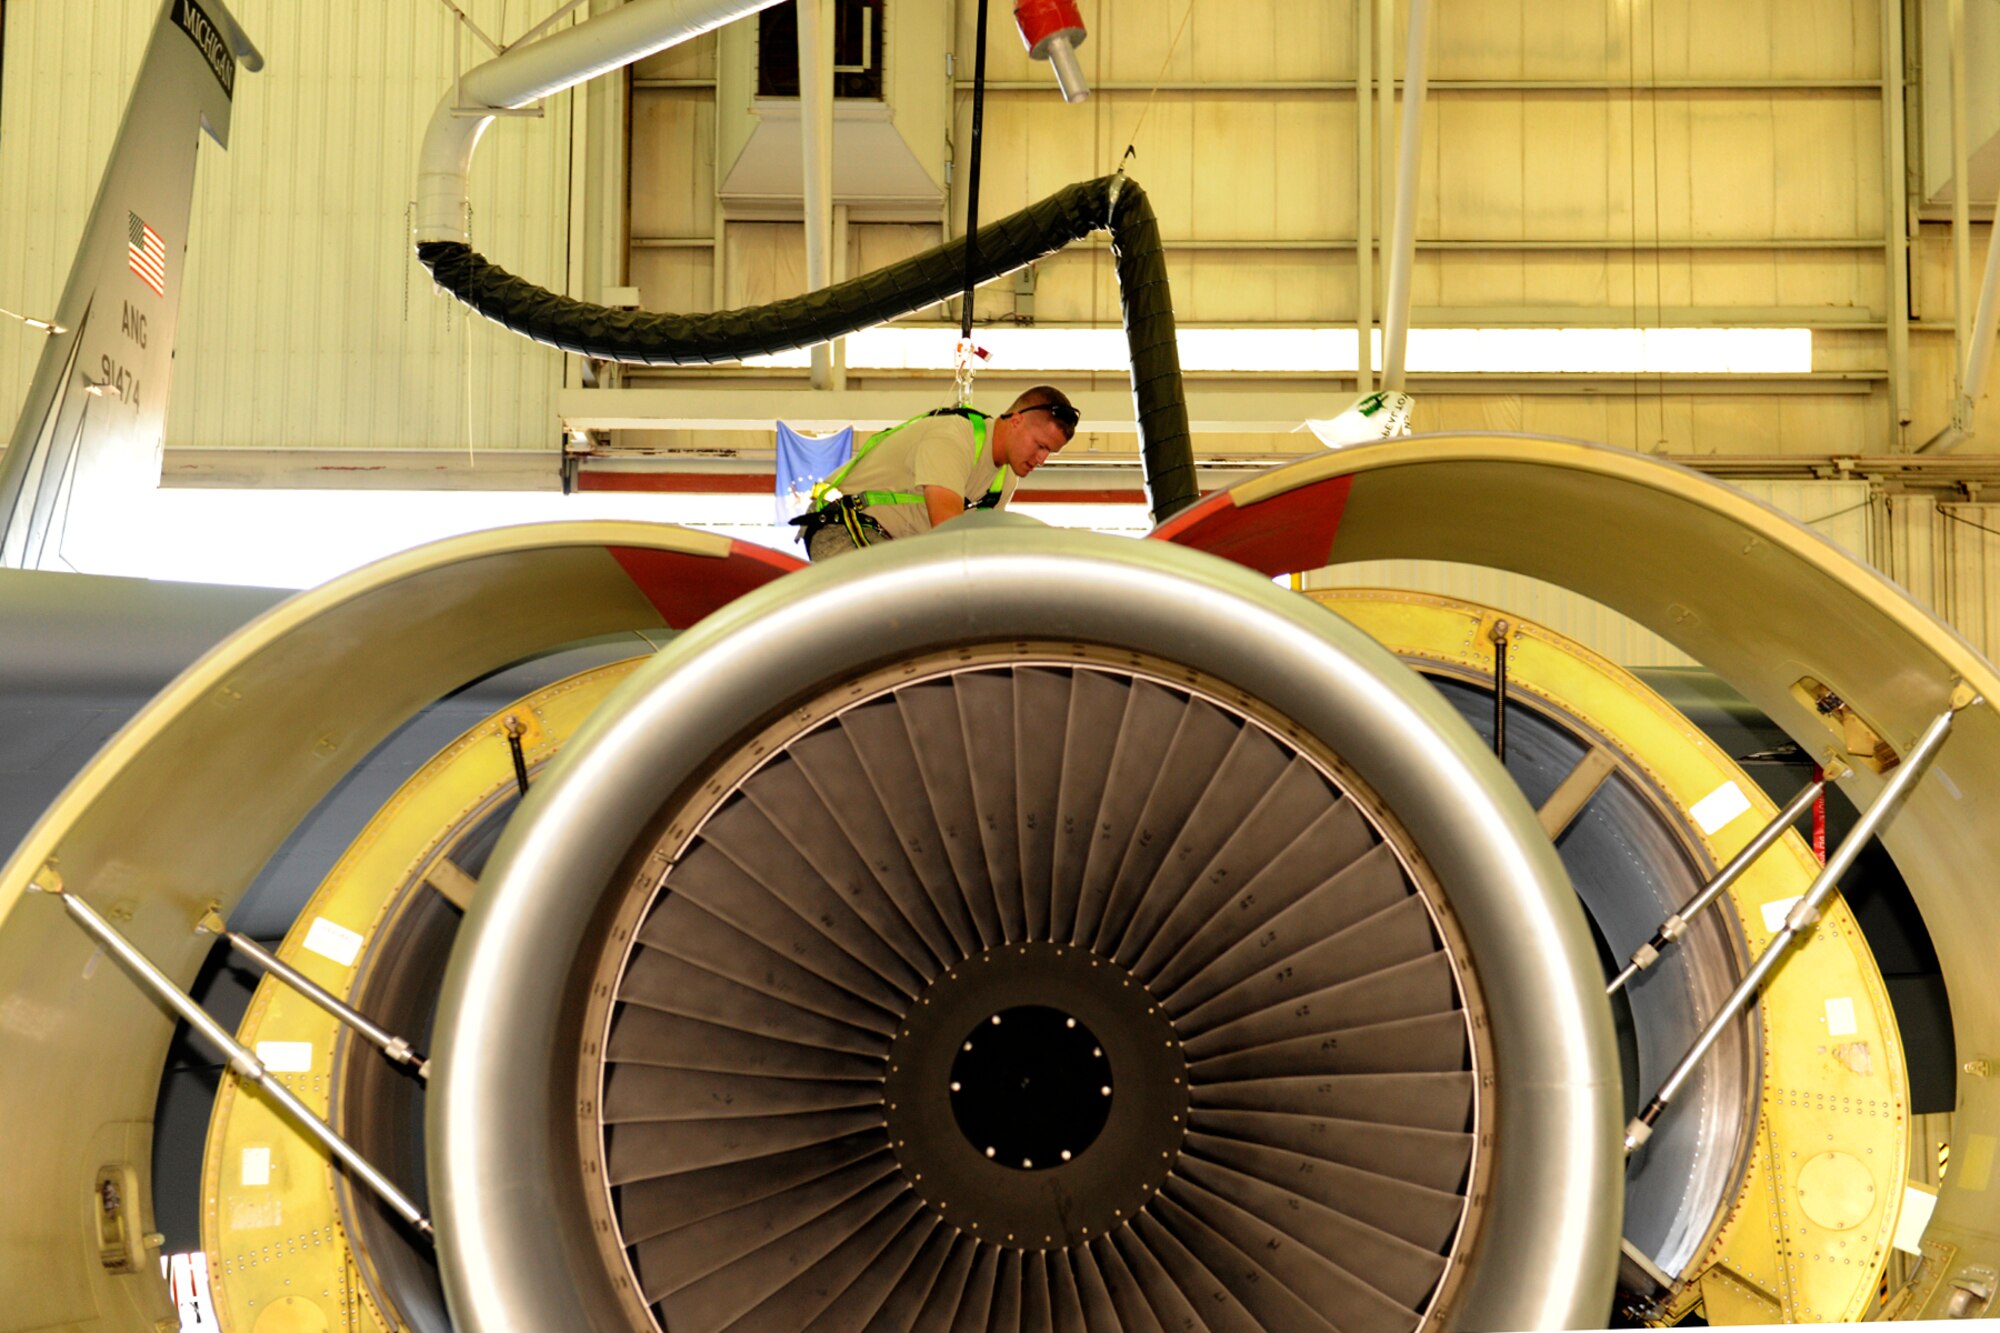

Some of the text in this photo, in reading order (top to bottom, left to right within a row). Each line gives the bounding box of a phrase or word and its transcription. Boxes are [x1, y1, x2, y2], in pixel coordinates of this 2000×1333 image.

[183, 0, 233, 90] MICHIGAN
[121, 299, 147, 350] ANG
[101, 353, 140, 415] 91474
